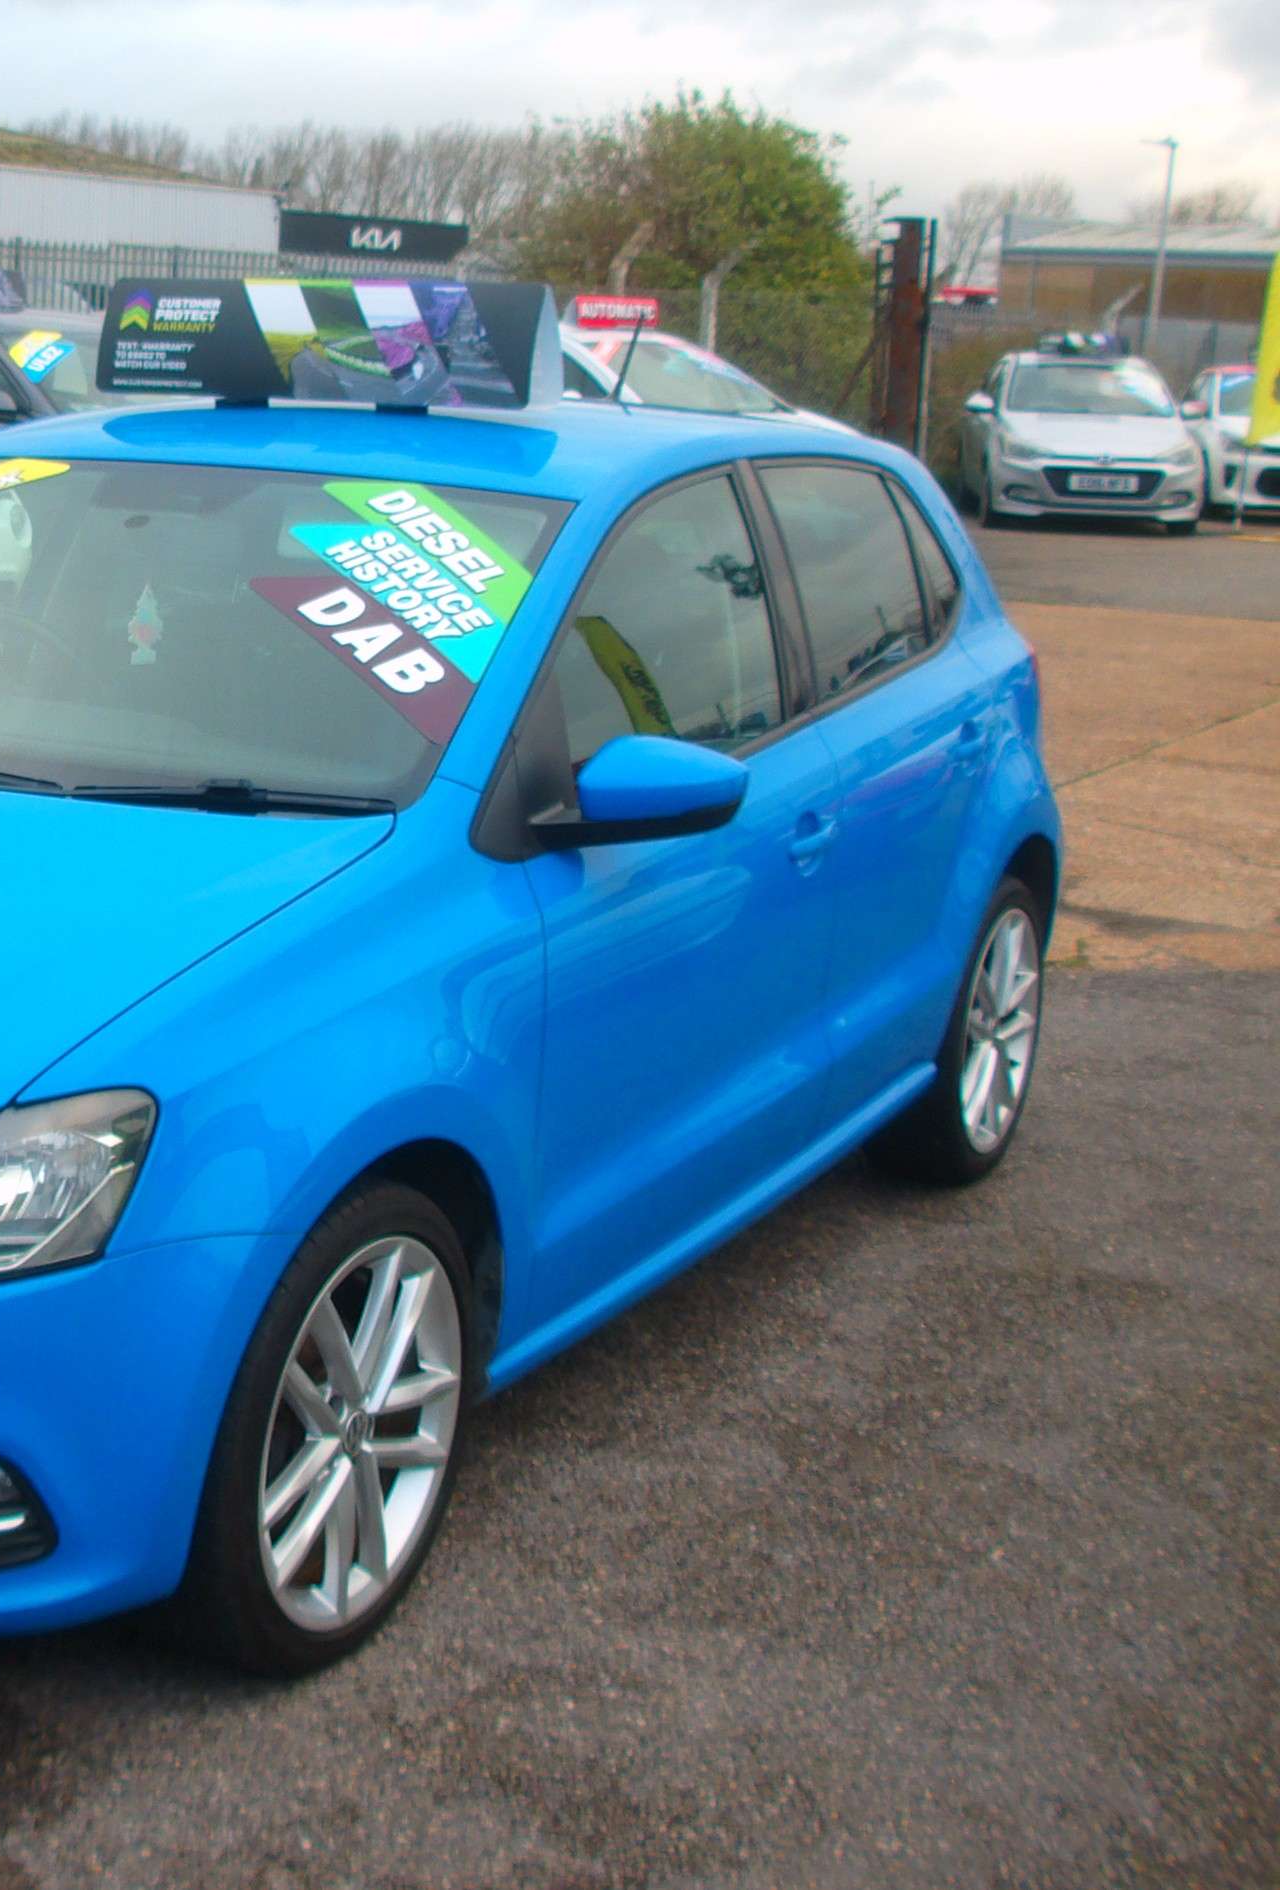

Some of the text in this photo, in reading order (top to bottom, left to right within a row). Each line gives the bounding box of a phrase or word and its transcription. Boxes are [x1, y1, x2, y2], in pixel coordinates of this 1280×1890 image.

[350, 226, 402, 251] KIA
[155, 309, 220, 322] PROTECT
[158, 297, 221, 310] CUSTOMER
[580, 302, 656, 321] AUTOMATIC
[153, 322, 216, 333] WARRANTY
[27, 345, 65, 372] ULEZ
[368, 489, 504, 594] DIESEL
[325, 539, 464, 640] HISTORY
[361, 530, 494, 634] SERVICE
[297, 587, 445, 694] DAB
